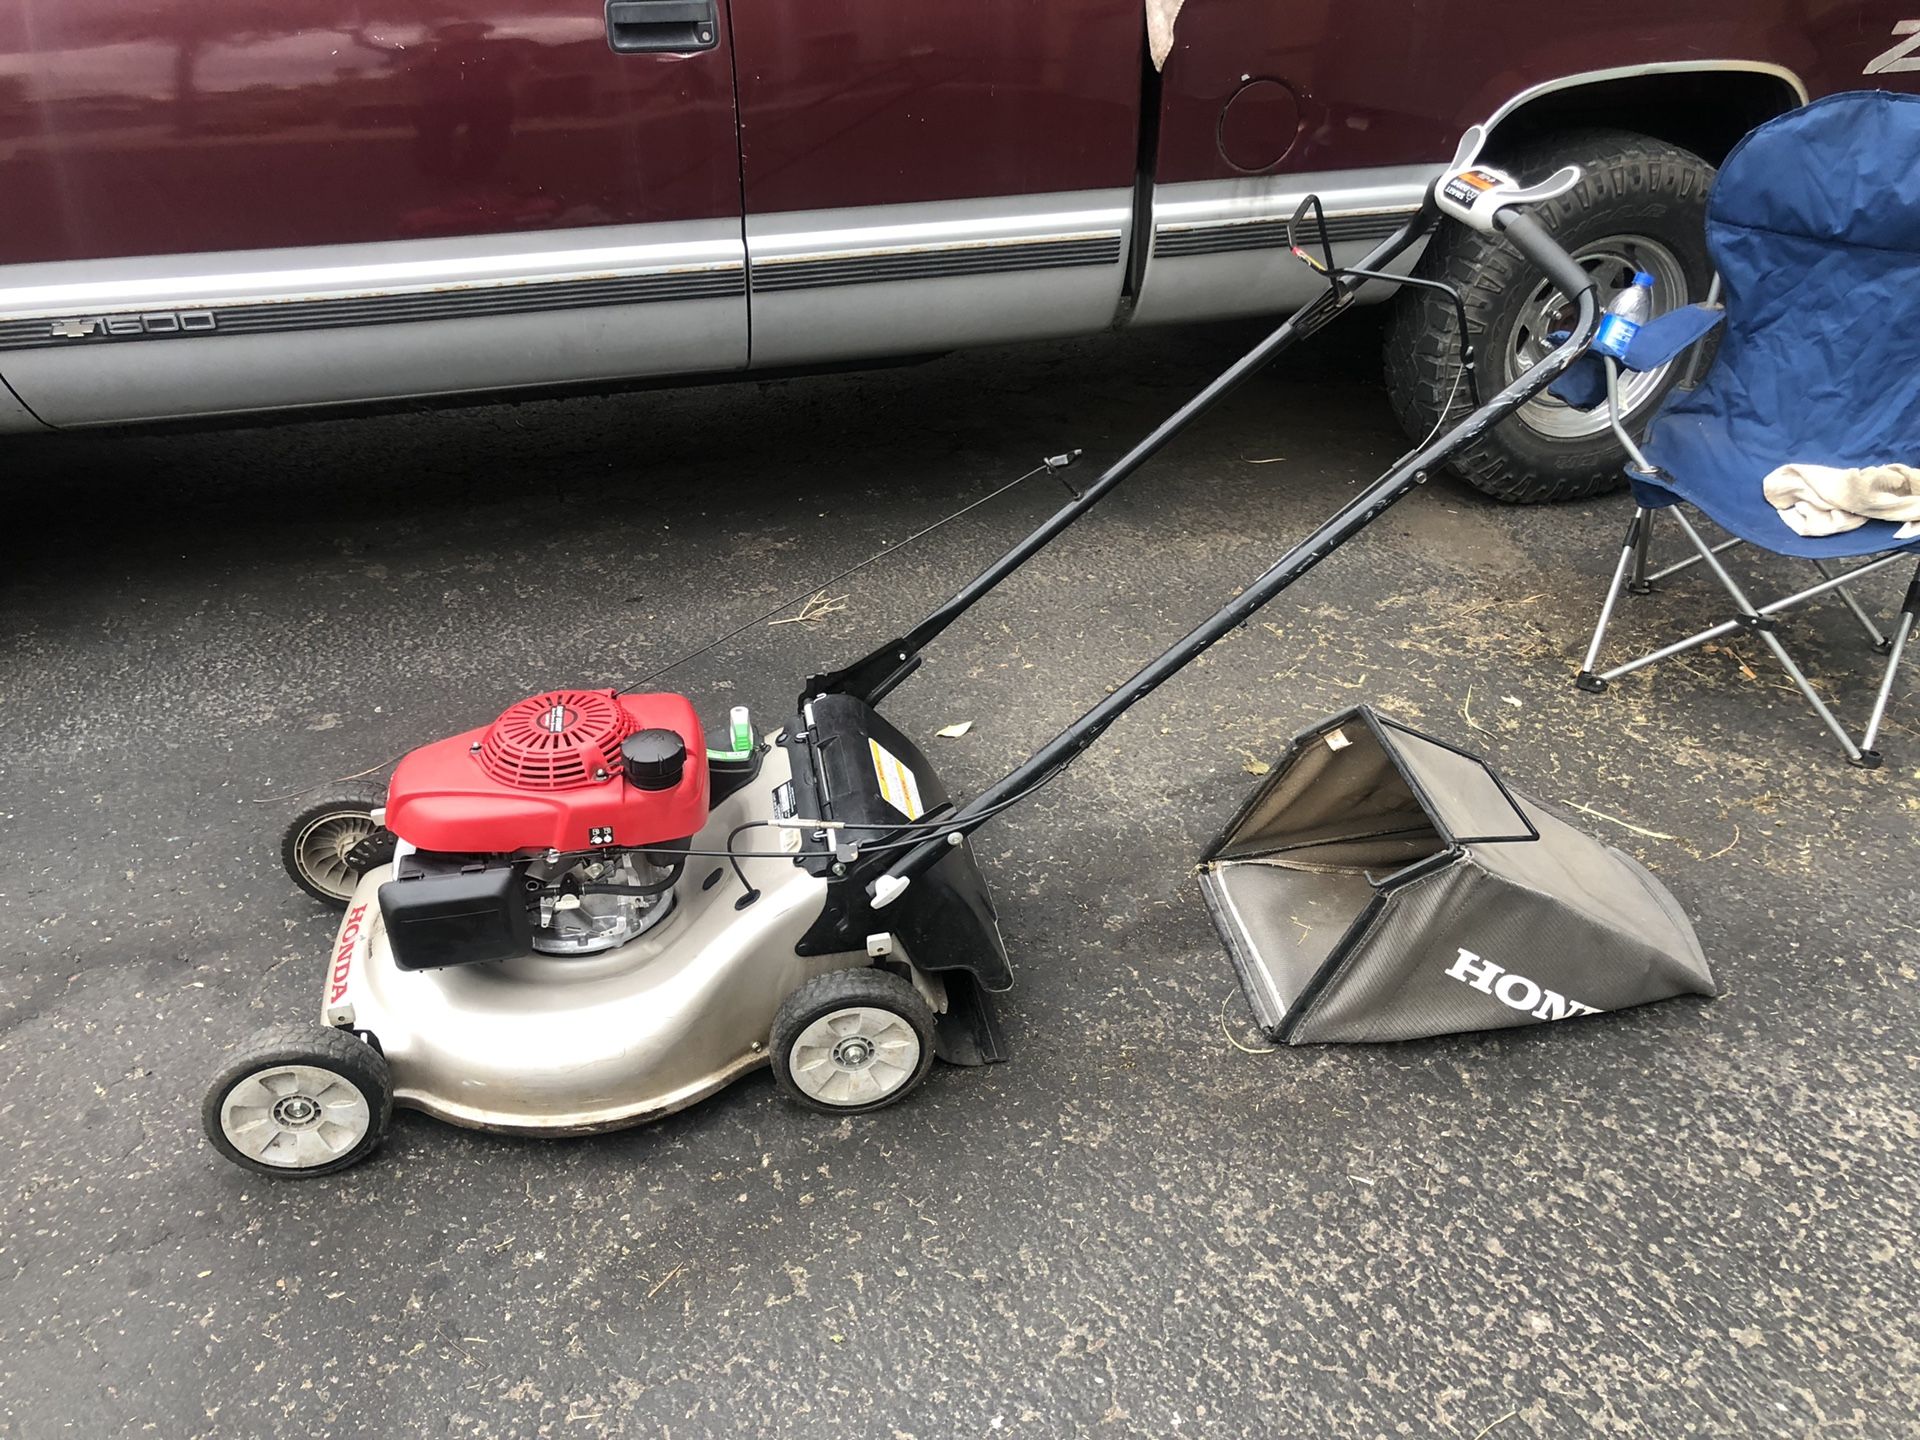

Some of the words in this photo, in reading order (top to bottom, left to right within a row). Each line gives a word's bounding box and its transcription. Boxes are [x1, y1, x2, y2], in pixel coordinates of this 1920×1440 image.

[99, 311, 217, 336] 1500
[331, 903, 368, 1004] HONDA
[1444, 947, 1605, 1021] HON
